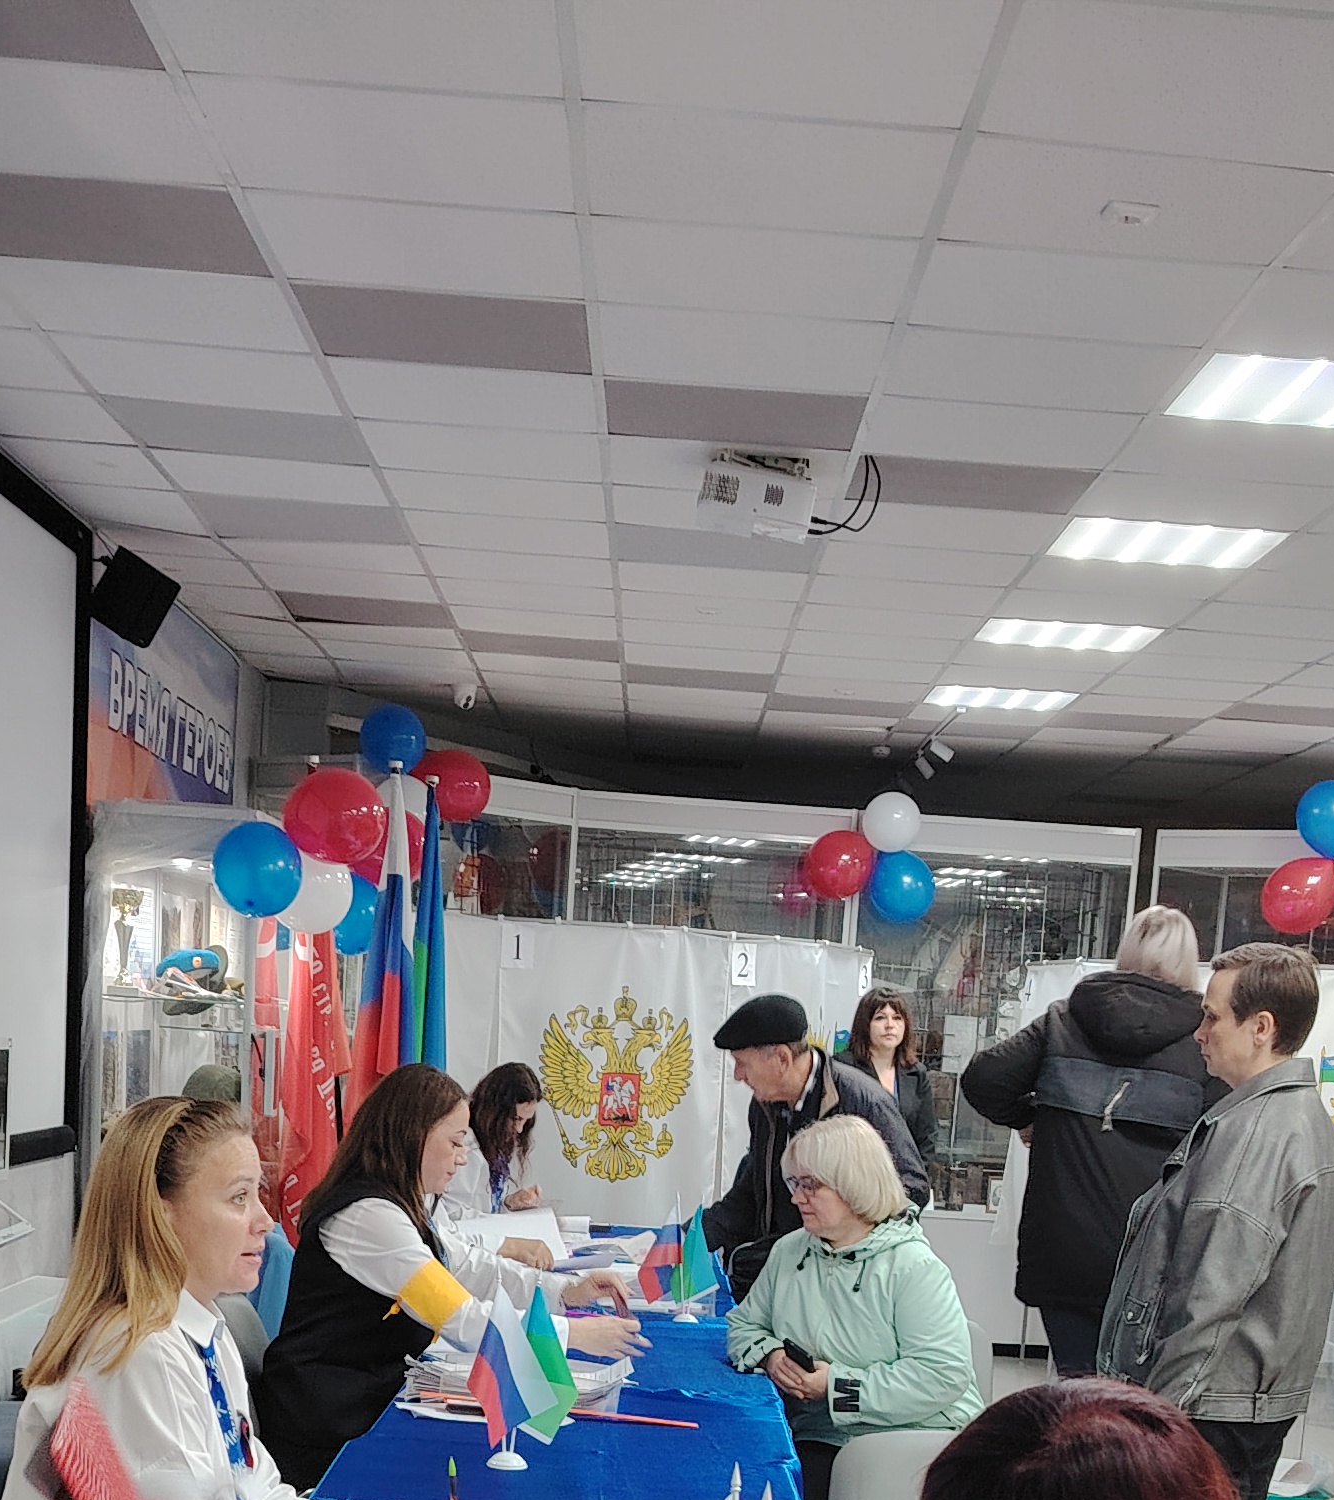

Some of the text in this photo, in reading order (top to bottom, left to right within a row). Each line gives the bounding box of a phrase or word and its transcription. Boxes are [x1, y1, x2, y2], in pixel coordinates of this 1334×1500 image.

[108, 648, 231, 796] ВРЕМЯ ГЕРОЕВ
[513, 934, 522, 961] 1
[737, 952, 749, 978] 2
[861, 964, 869, 990] 3
